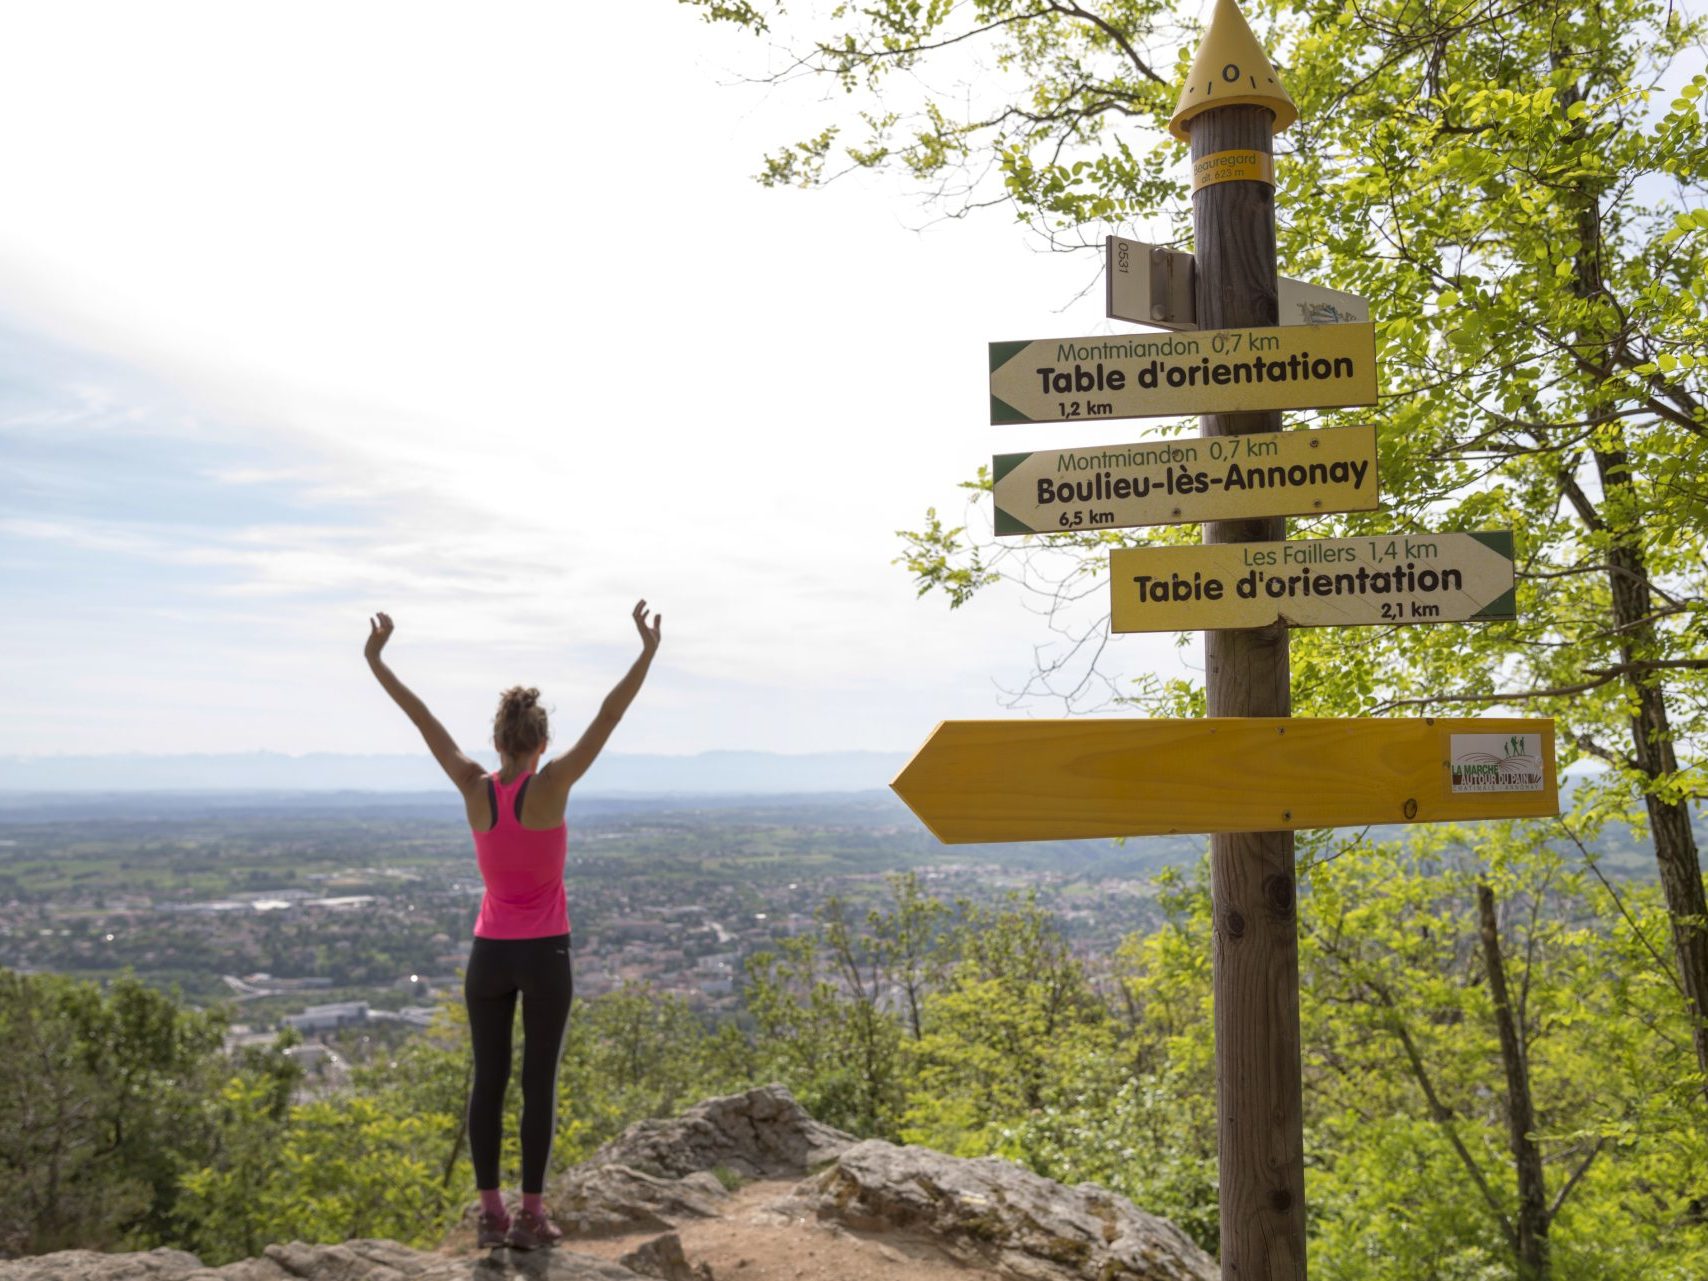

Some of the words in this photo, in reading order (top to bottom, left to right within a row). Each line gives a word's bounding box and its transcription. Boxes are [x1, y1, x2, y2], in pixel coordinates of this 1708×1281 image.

[1193, 153, 1256, 176] Beauregard
[1214, 168, 1233, 179] 623
[1234, 169, 1245, 177] m
[1117, 242, 1129, 275] 0531
[1057, 339, 1200, 363] Montmiandon
[1211, 334, 1243, 355] 0,7
[1248, 332, 1280, 352] km
[1036, 365, 1126, 395] Table
[1137, 351, 1354, 390] d'orientation
[1058, 402, 1081, 418] 1,2
[1086, 400, 1113, 416] km
[1057, 446, 1198, 473] Montmiandon
[1209, 441, 1241, 461] 0,7
[1246, 438, 1279, 458] km
[1037, 459, 1369, 505] Boulieu-lès-Annonay
[1058, 511, 1084, 528] 6,5
[1089, 509, 1115, 525] km
[1243, 547, 1277, 567] Les
[1284, 543, 1356, 565] Faillers
[1369, 541, 1398, 565] 1,4
[1404, 538, 1438, 559] km
[1132, 571, 1224, 603] Table
[1236, 562, 1462, 599] d'orientation
[1380, 603, 1404, 620] 2,1
[1410, 601, 1440, 617] km
[1452, 764, 1462, 775] LA
[1463, 764, 1499, 775] MARCHE
[1461, 774, 1497, 785] AUTOUR
[1498, 773, 1509, 785] DU
[1510, 773, 1529, 785] PAIN
